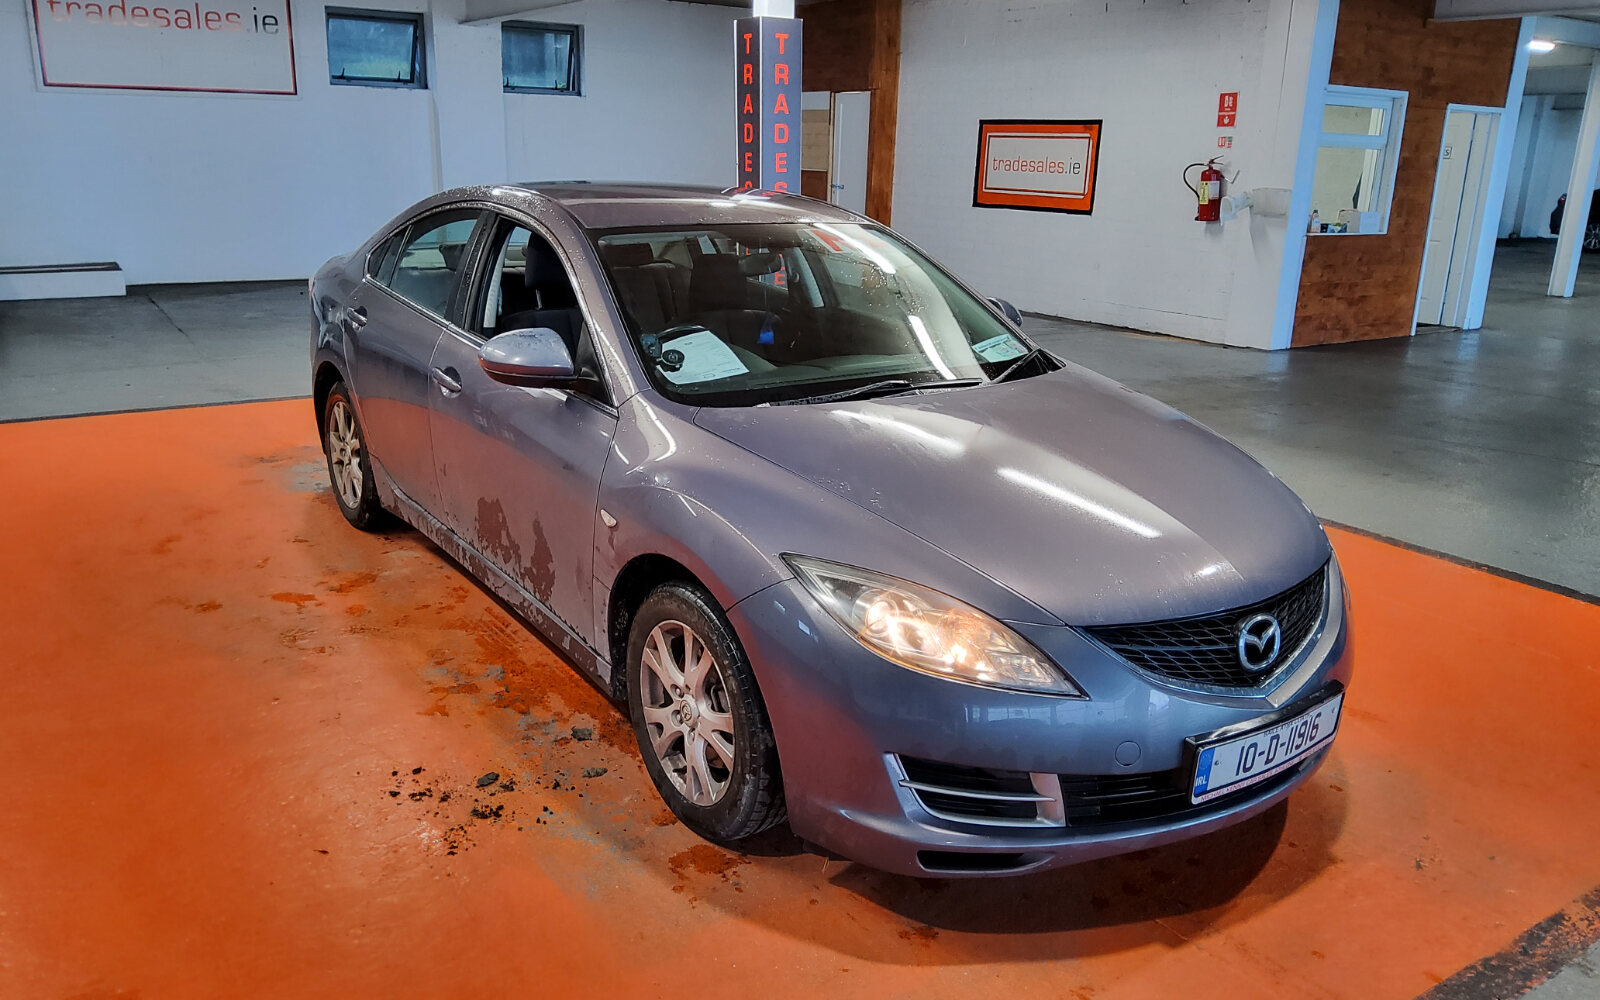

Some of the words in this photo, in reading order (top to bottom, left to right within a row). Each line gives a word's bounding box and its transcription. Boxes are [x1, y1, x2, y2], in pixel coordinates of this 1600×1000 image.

[992, 155, 1081, 175] tradesales.ie
[1235, 711, 1322, 776] 10-D-11916
[1195, 775, 1208, 787] IRL
